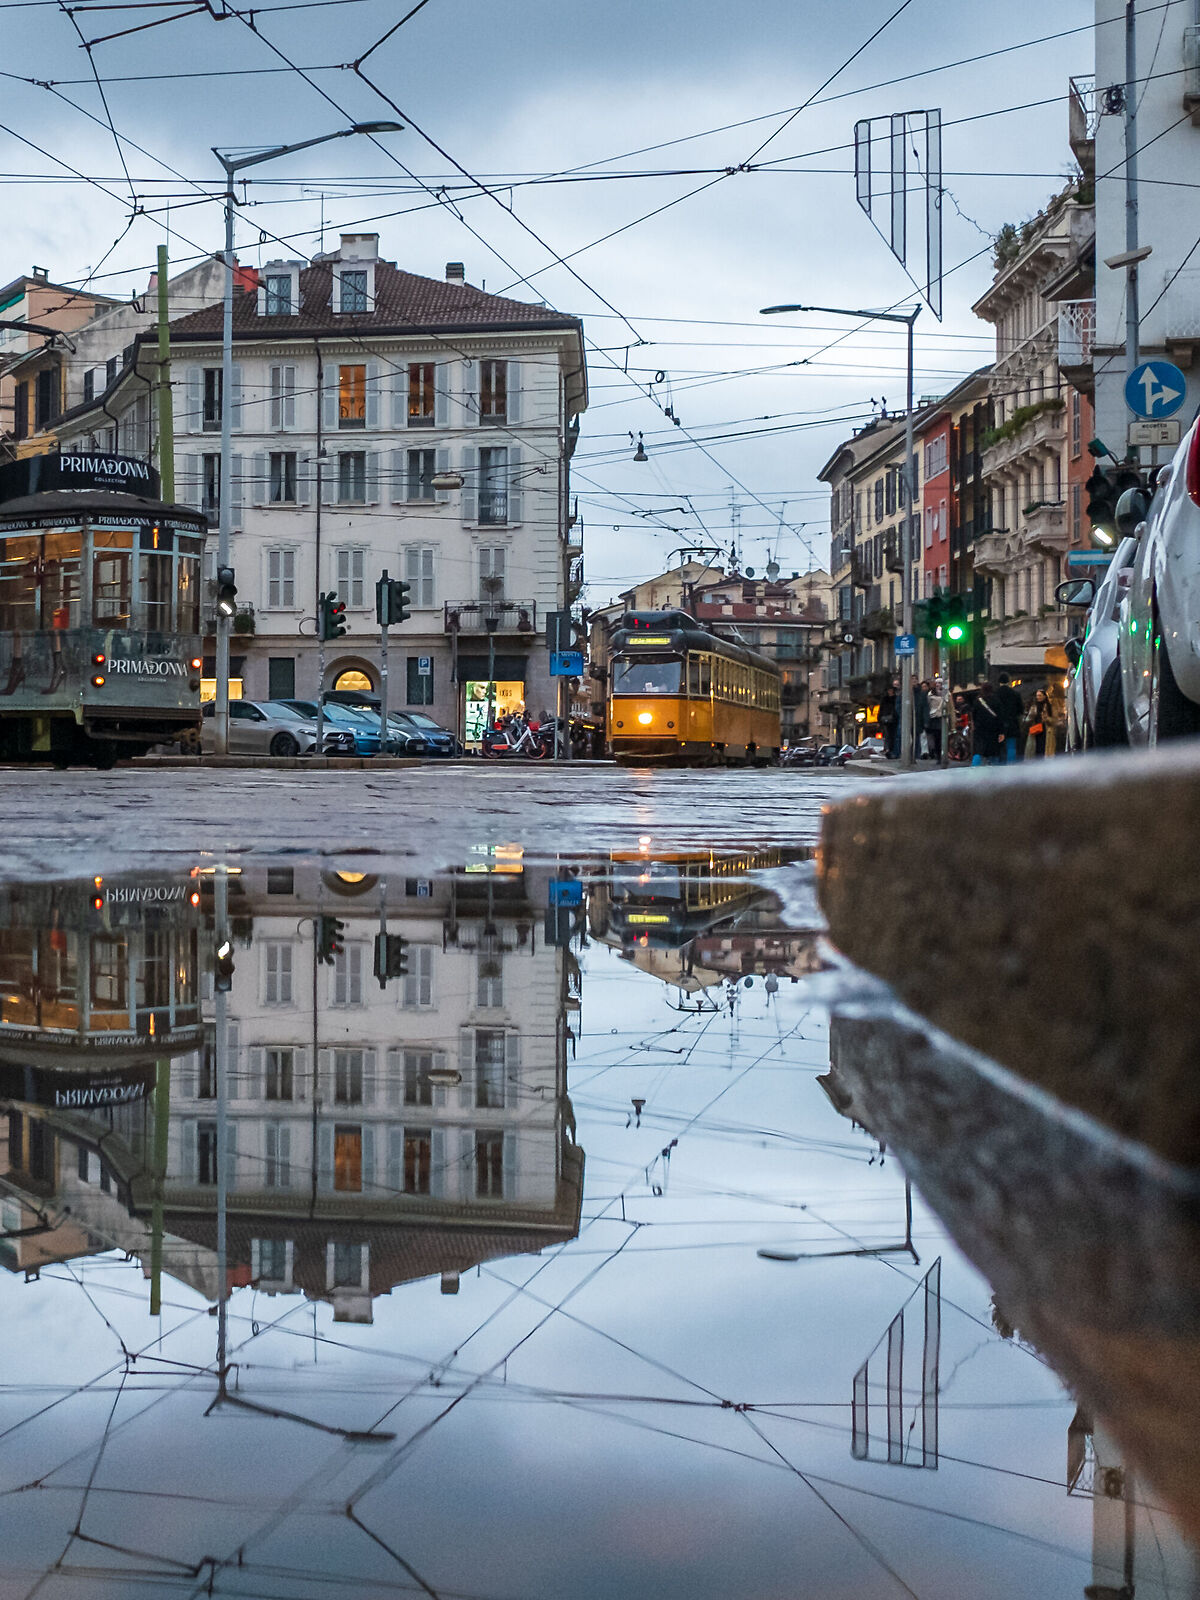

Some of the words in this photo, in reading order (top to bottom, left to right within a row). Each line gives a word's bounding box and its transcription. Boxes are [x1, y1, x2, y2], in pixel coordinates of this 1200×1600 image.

[60, 456, 149, 480] PRIMADONNA
[94, 476, 127, 484] COLLECTION
[98, 516, 150, 526] PRIMADONNA
[107, 659, 188, 677] PRIMADONNA
